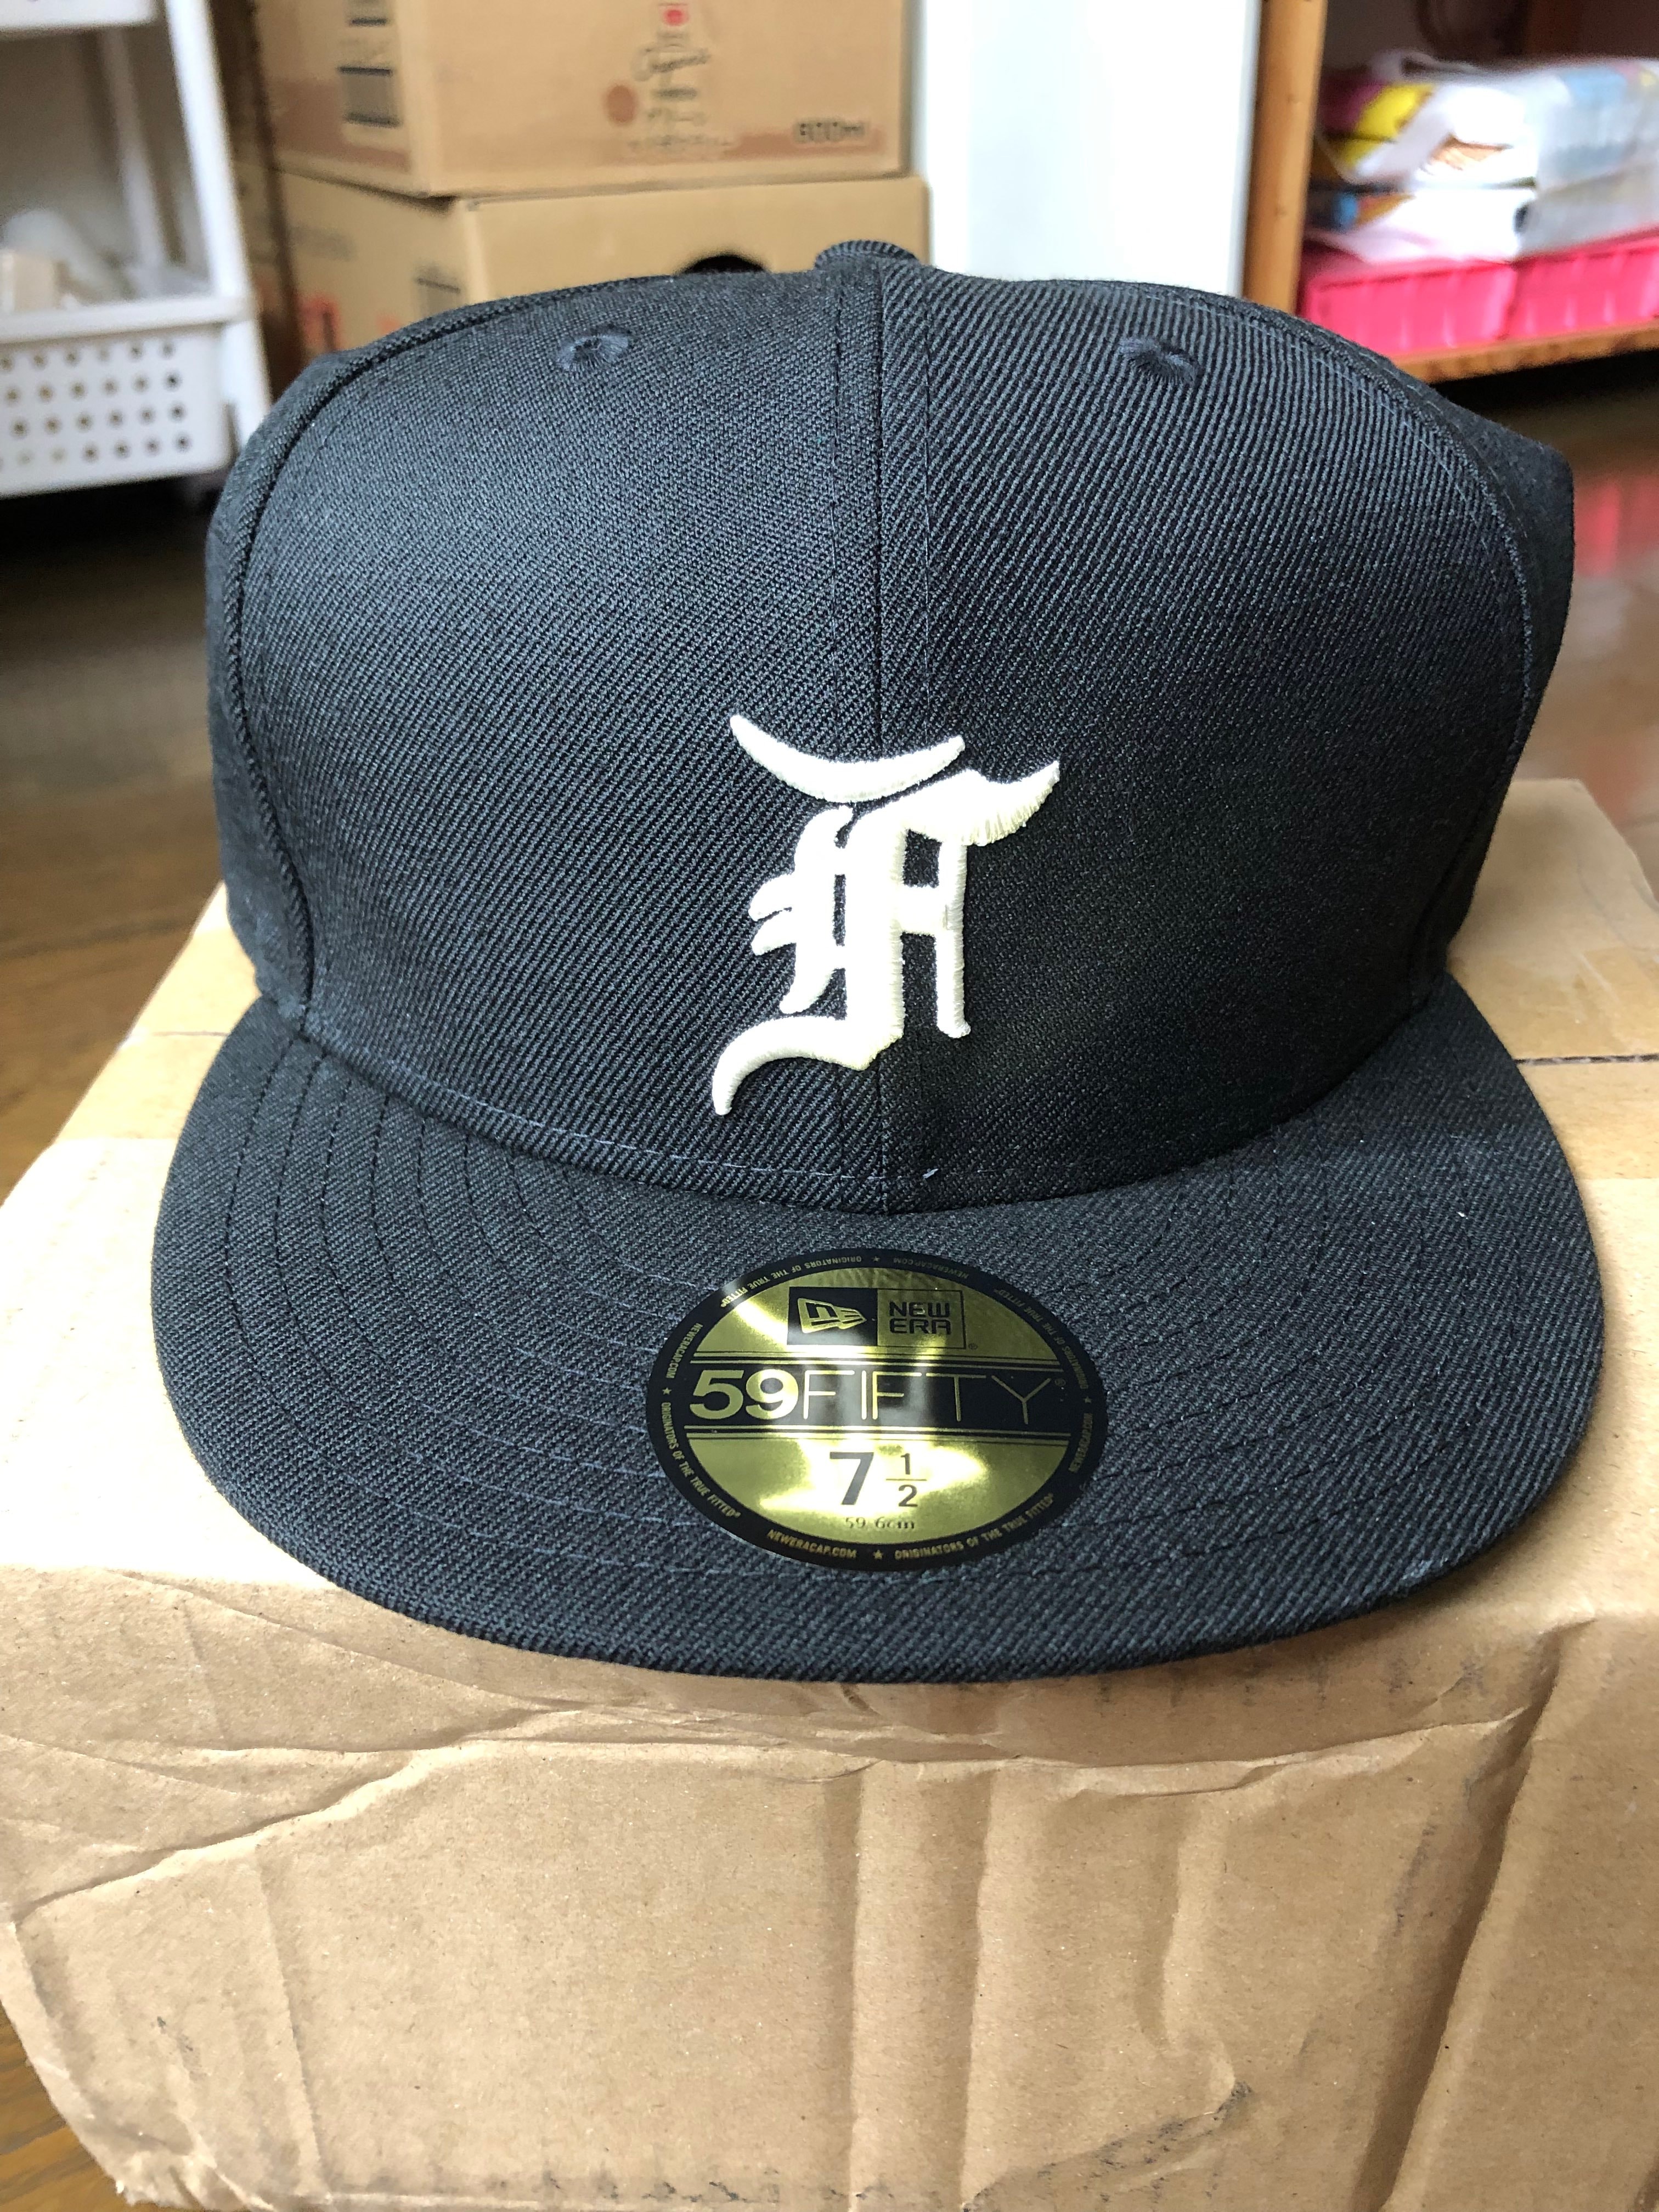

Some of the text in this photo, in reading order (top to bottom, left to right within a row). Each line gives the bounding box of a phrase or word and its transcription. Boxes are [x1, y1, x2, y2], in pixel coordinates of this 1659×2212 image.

[791, 1265, 802, 1273] OF
[804, 1255, 862, 1269] ORIGINATORS
[893, 1257, 969, 1279] NEWERACAP.COM
[770, 1268, 790, 1279] THE
[747, 1276, 771, 1290] TRUE
[889, 1301, 951, 1318] NEW
[1023, 1307, 1043, 1323] TRUE
[889, 1318, 951, 1335] ERA
[1042, 1322, 1058, 1336] THE
[1053, 1336, 1065, 1345] OF
[665, 1322, 703, 1379] NEWERACAP.COM
[689, 1369, 1052, 1425] 59FIFTY
[661, 1402, 679, 1450] ORIGINATORS
[672, 1450, 685, 1460] OF
[679, 1460, 695, 1477] THE
[690, 1476, 711, 1497] TRUE
[829, 1452, 874, 1505] 7
[845, 1516, 916, 1530] 596cm
[767, 1528, 857, 1559] NEWERACAP.COM
[894, 1541, 964, 1561] ORIGINATORS
[966, 1537, 979, 1548] OF
[981, 1528, 1003, 1542] THE
[1002, 1515, 1028, 1532] TRUE
